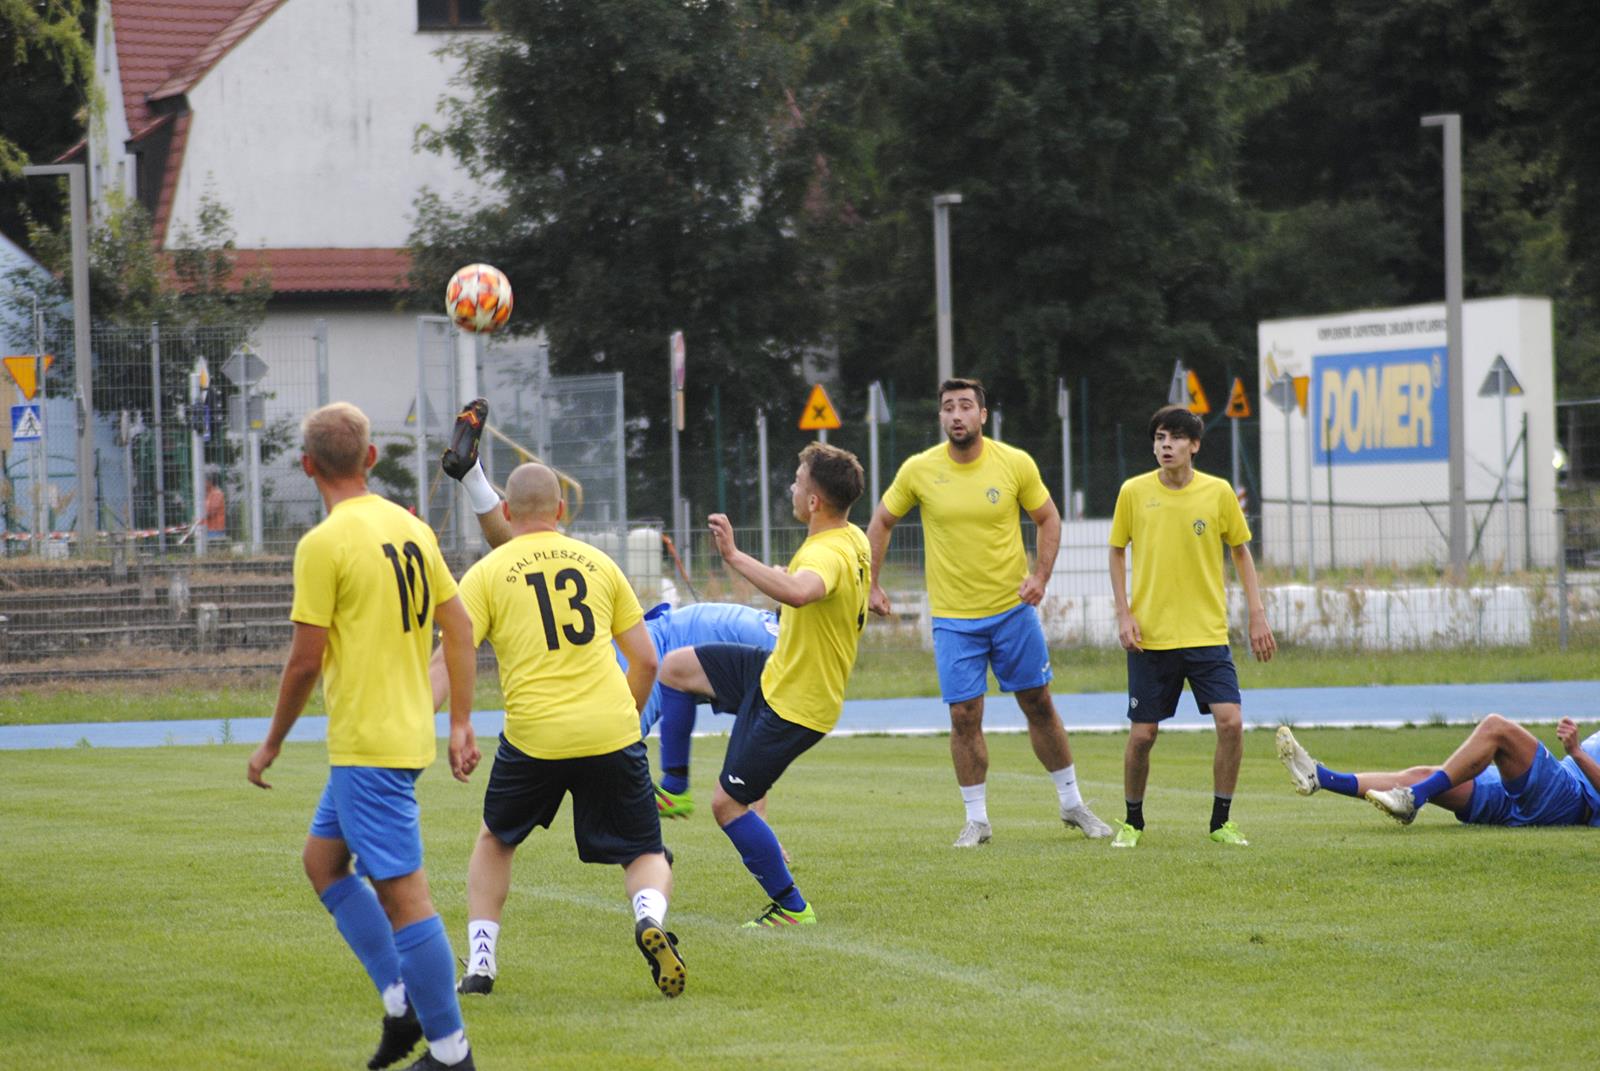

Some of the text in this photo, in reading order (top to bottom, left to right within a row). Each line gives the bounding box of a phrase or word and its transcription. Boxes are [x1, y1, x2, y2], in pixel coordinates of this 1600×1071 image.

[1320, 361, 1433, 453] DOMER
[381, 540, 431, 633] 10
[506, 549, 598, 584] STAL PLESZEW
[524, 567, 596, 652] 13
